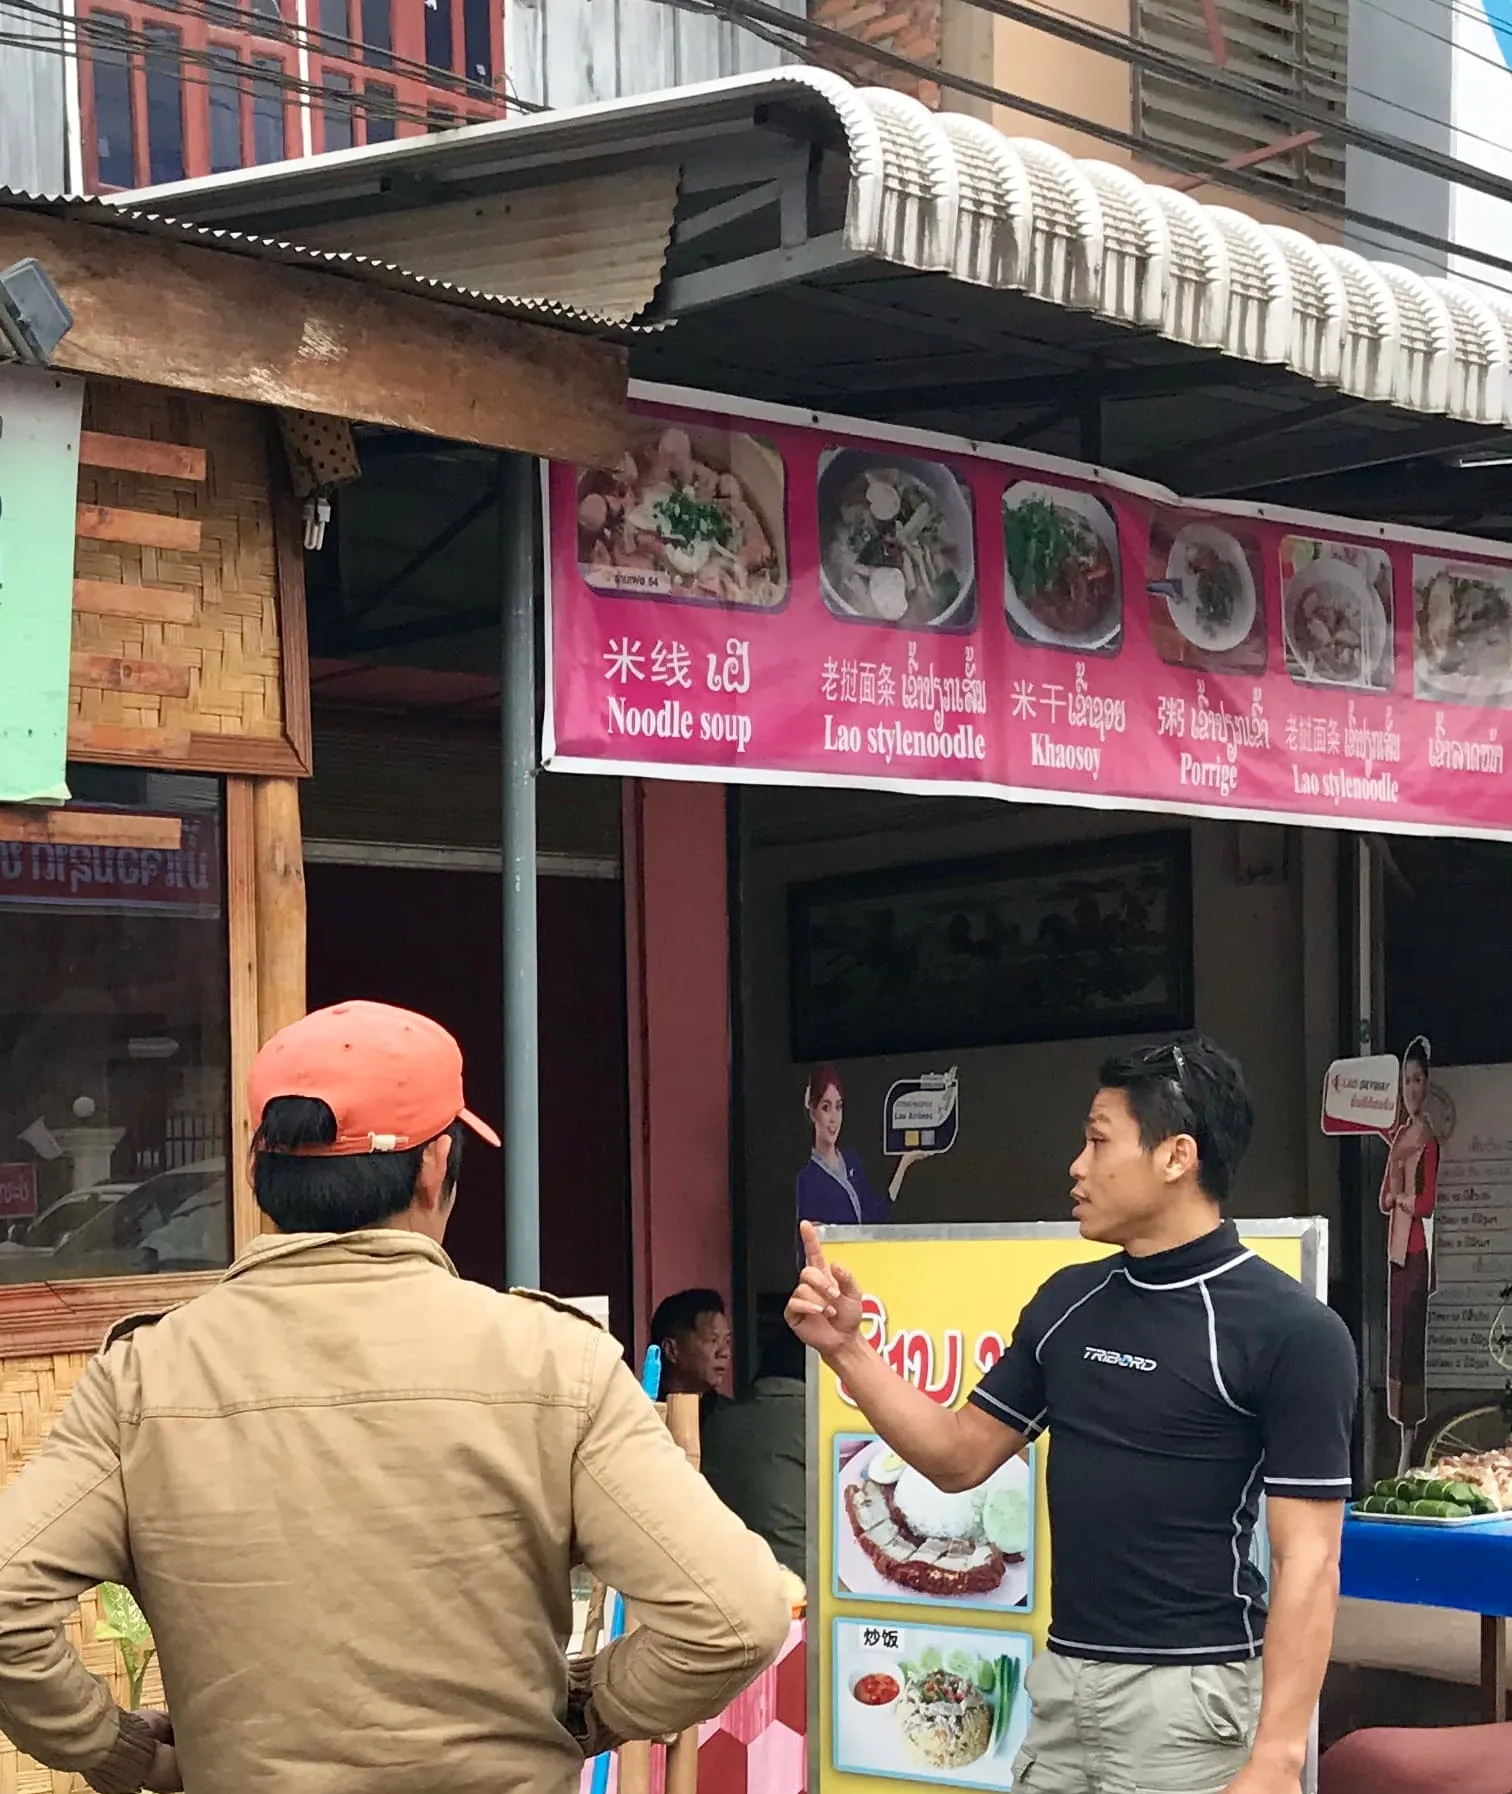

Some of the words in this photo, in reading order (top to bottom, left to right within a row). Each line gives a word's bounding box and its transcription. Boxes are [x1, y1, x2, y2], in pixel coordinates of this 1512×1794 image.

[603, 637, 693, 689] 米线
[821, 656, 896, 708] 老挝面条
[1010, 679, 1067, 724] 米干
[1157, 696, 1185, 738] 粥
[607, 696, 693, 740] Noodle
[700, 712, 752, 753] soup
[824, 714, 862, 753] Lao
[867, 720, 986, 765] stylenoodle
[1030, 732, 1102, 781] Khaosoy
[1180, 752, 1238, 797] Porrige
[1292, 763, 1320, 796] Lao
[1322, 767, 1399, 806] stylenoodle
[1083, 1346, 1158, 1372] TRIBORD
[863, 1627, 899, 1649] 炒饭
